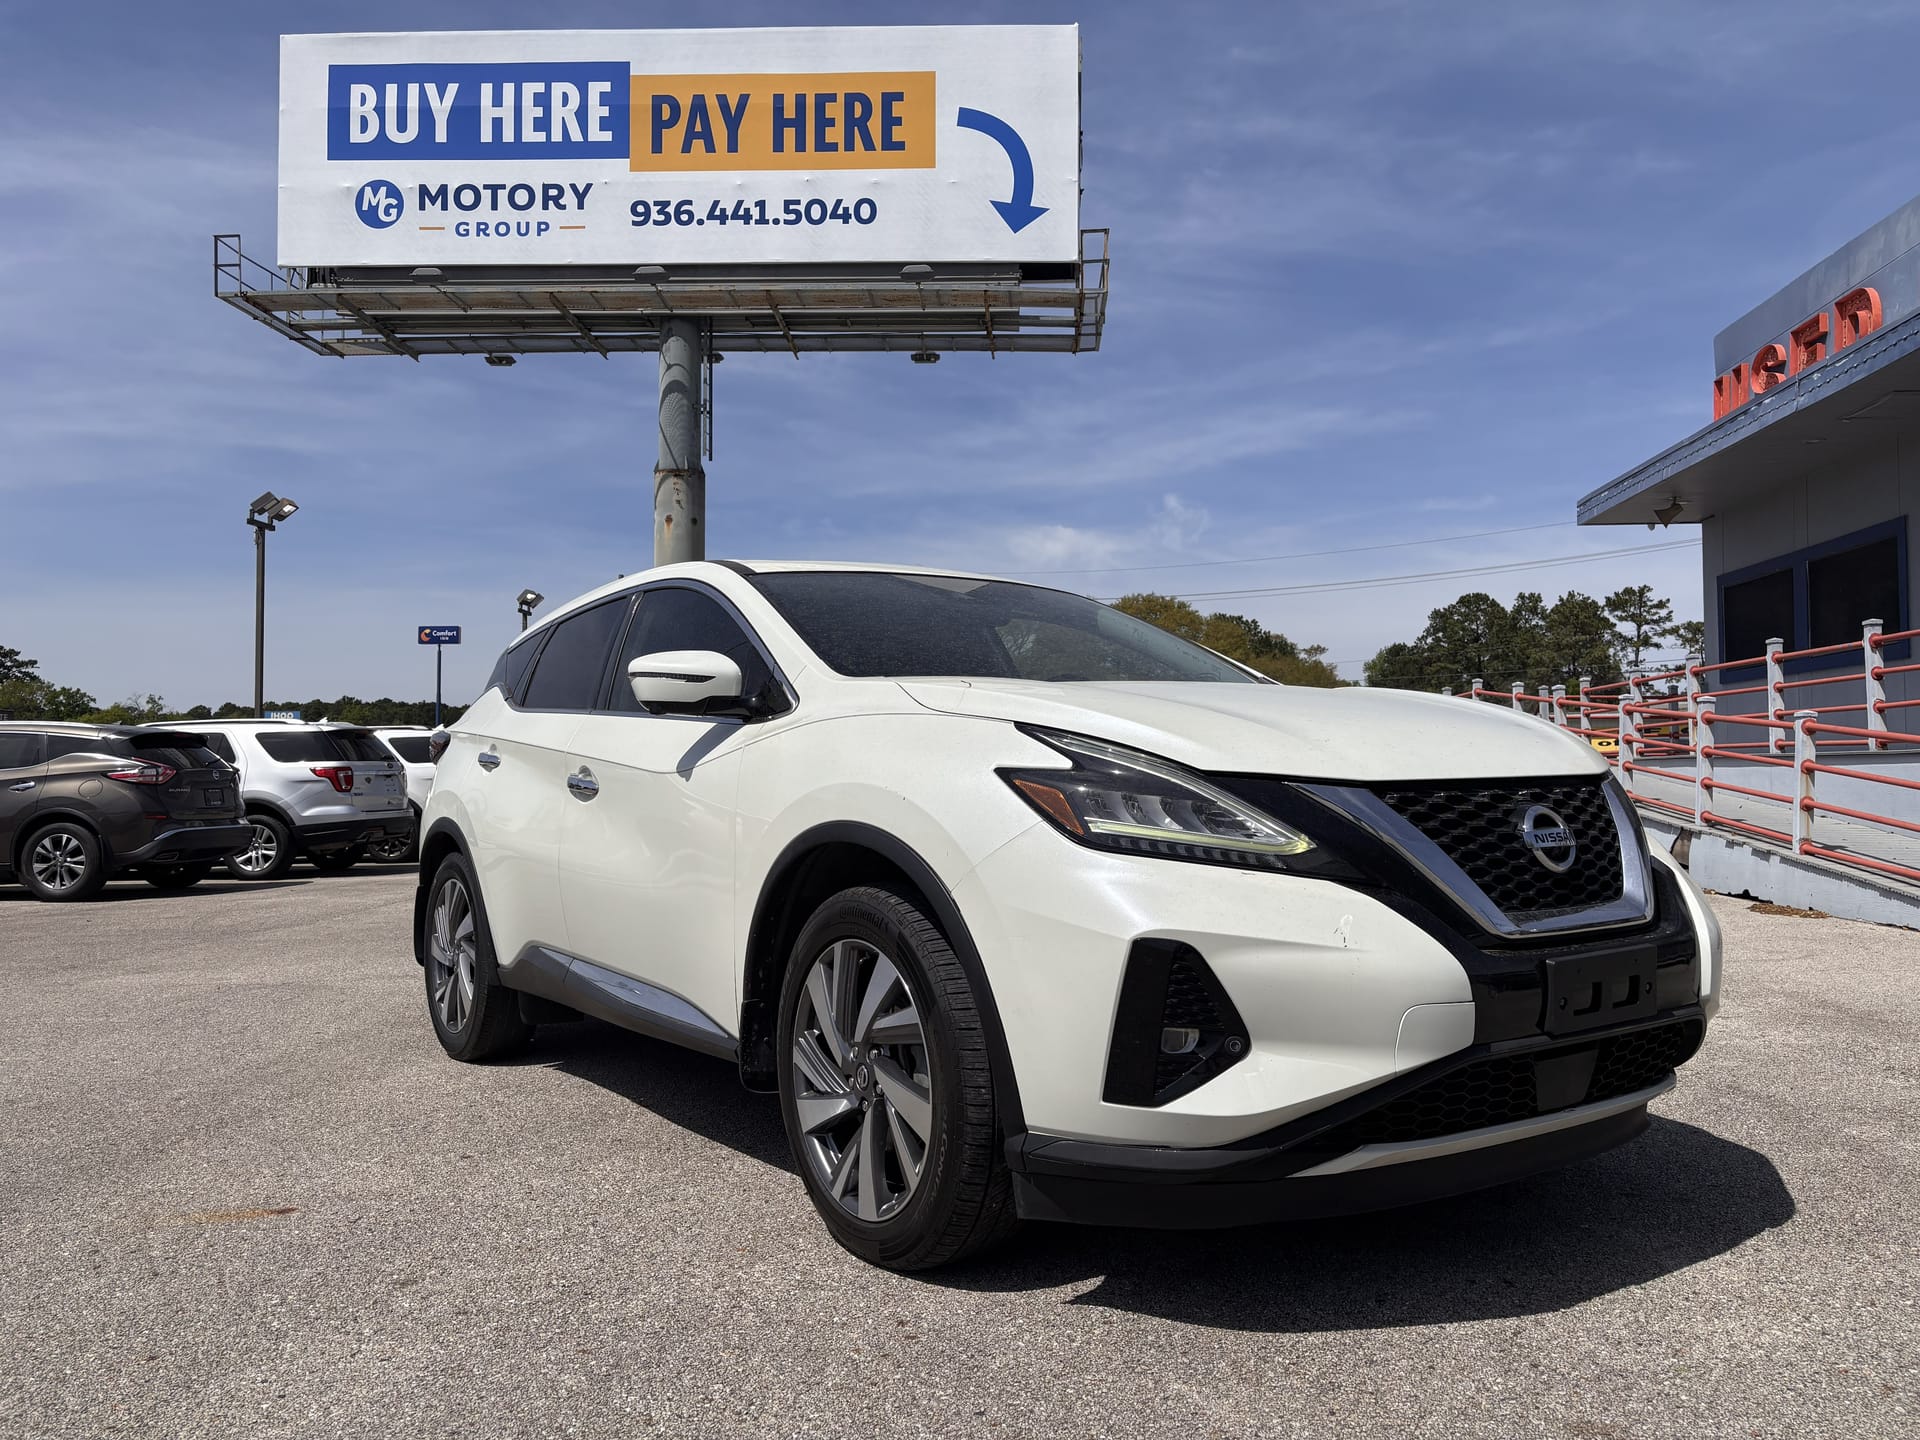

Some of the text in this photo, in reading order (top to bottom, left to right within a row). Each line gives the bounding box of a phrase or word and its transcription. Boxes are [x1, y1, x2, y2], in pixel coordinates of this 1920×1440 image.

[350, 82, 613, 144] BUY HERE
[651, 92, 906, 154] PAY HERE
[361, 186, 399, 223] MG
[418, 182, 594, 211] MOTORY
[630, 198, 878, 227] 936.441.5040
[455, 221, 550, 237] GROUP
